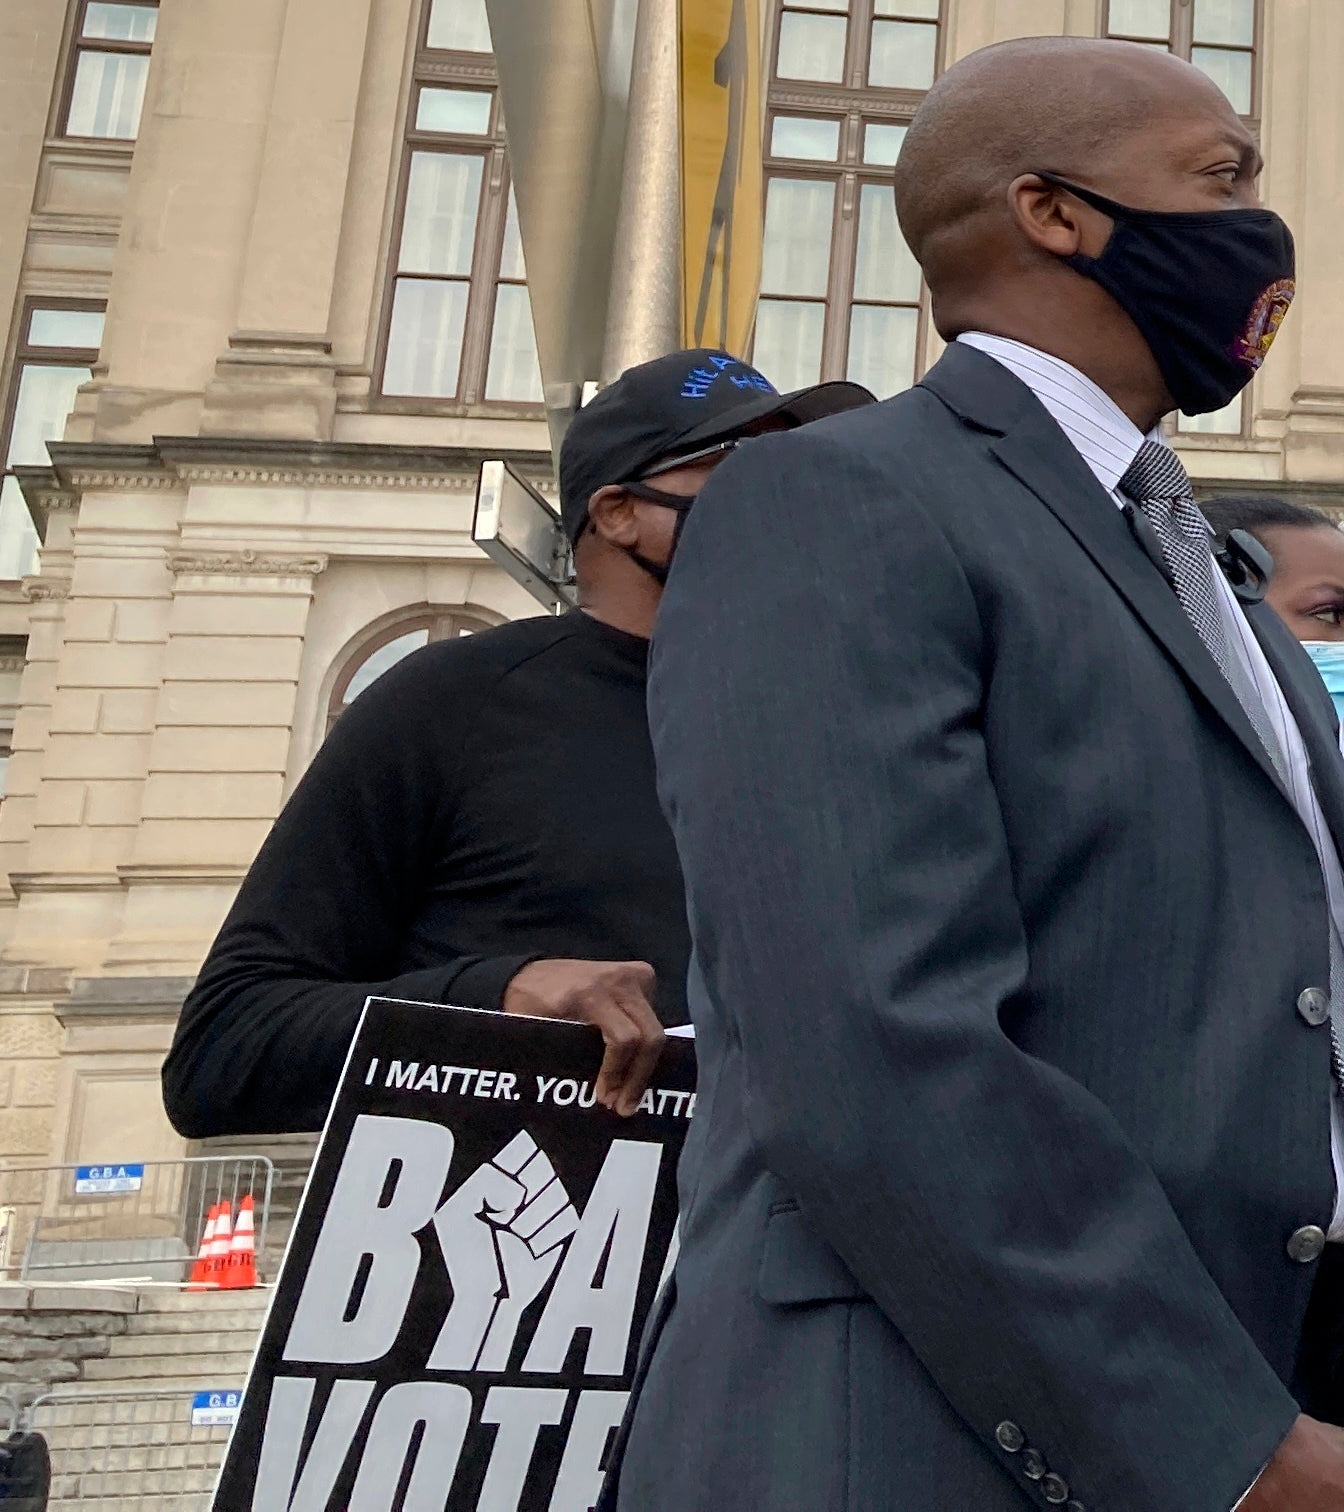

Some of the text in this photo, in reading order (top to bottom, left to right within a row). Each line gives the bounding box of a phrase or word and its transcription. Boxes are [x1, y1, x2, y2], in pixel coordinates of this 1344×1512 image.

[365, 1058, 379, 1085] I
[384, 1059, 521, 1101] MATTER.
[535, 1074, 597, 1108] YOU
